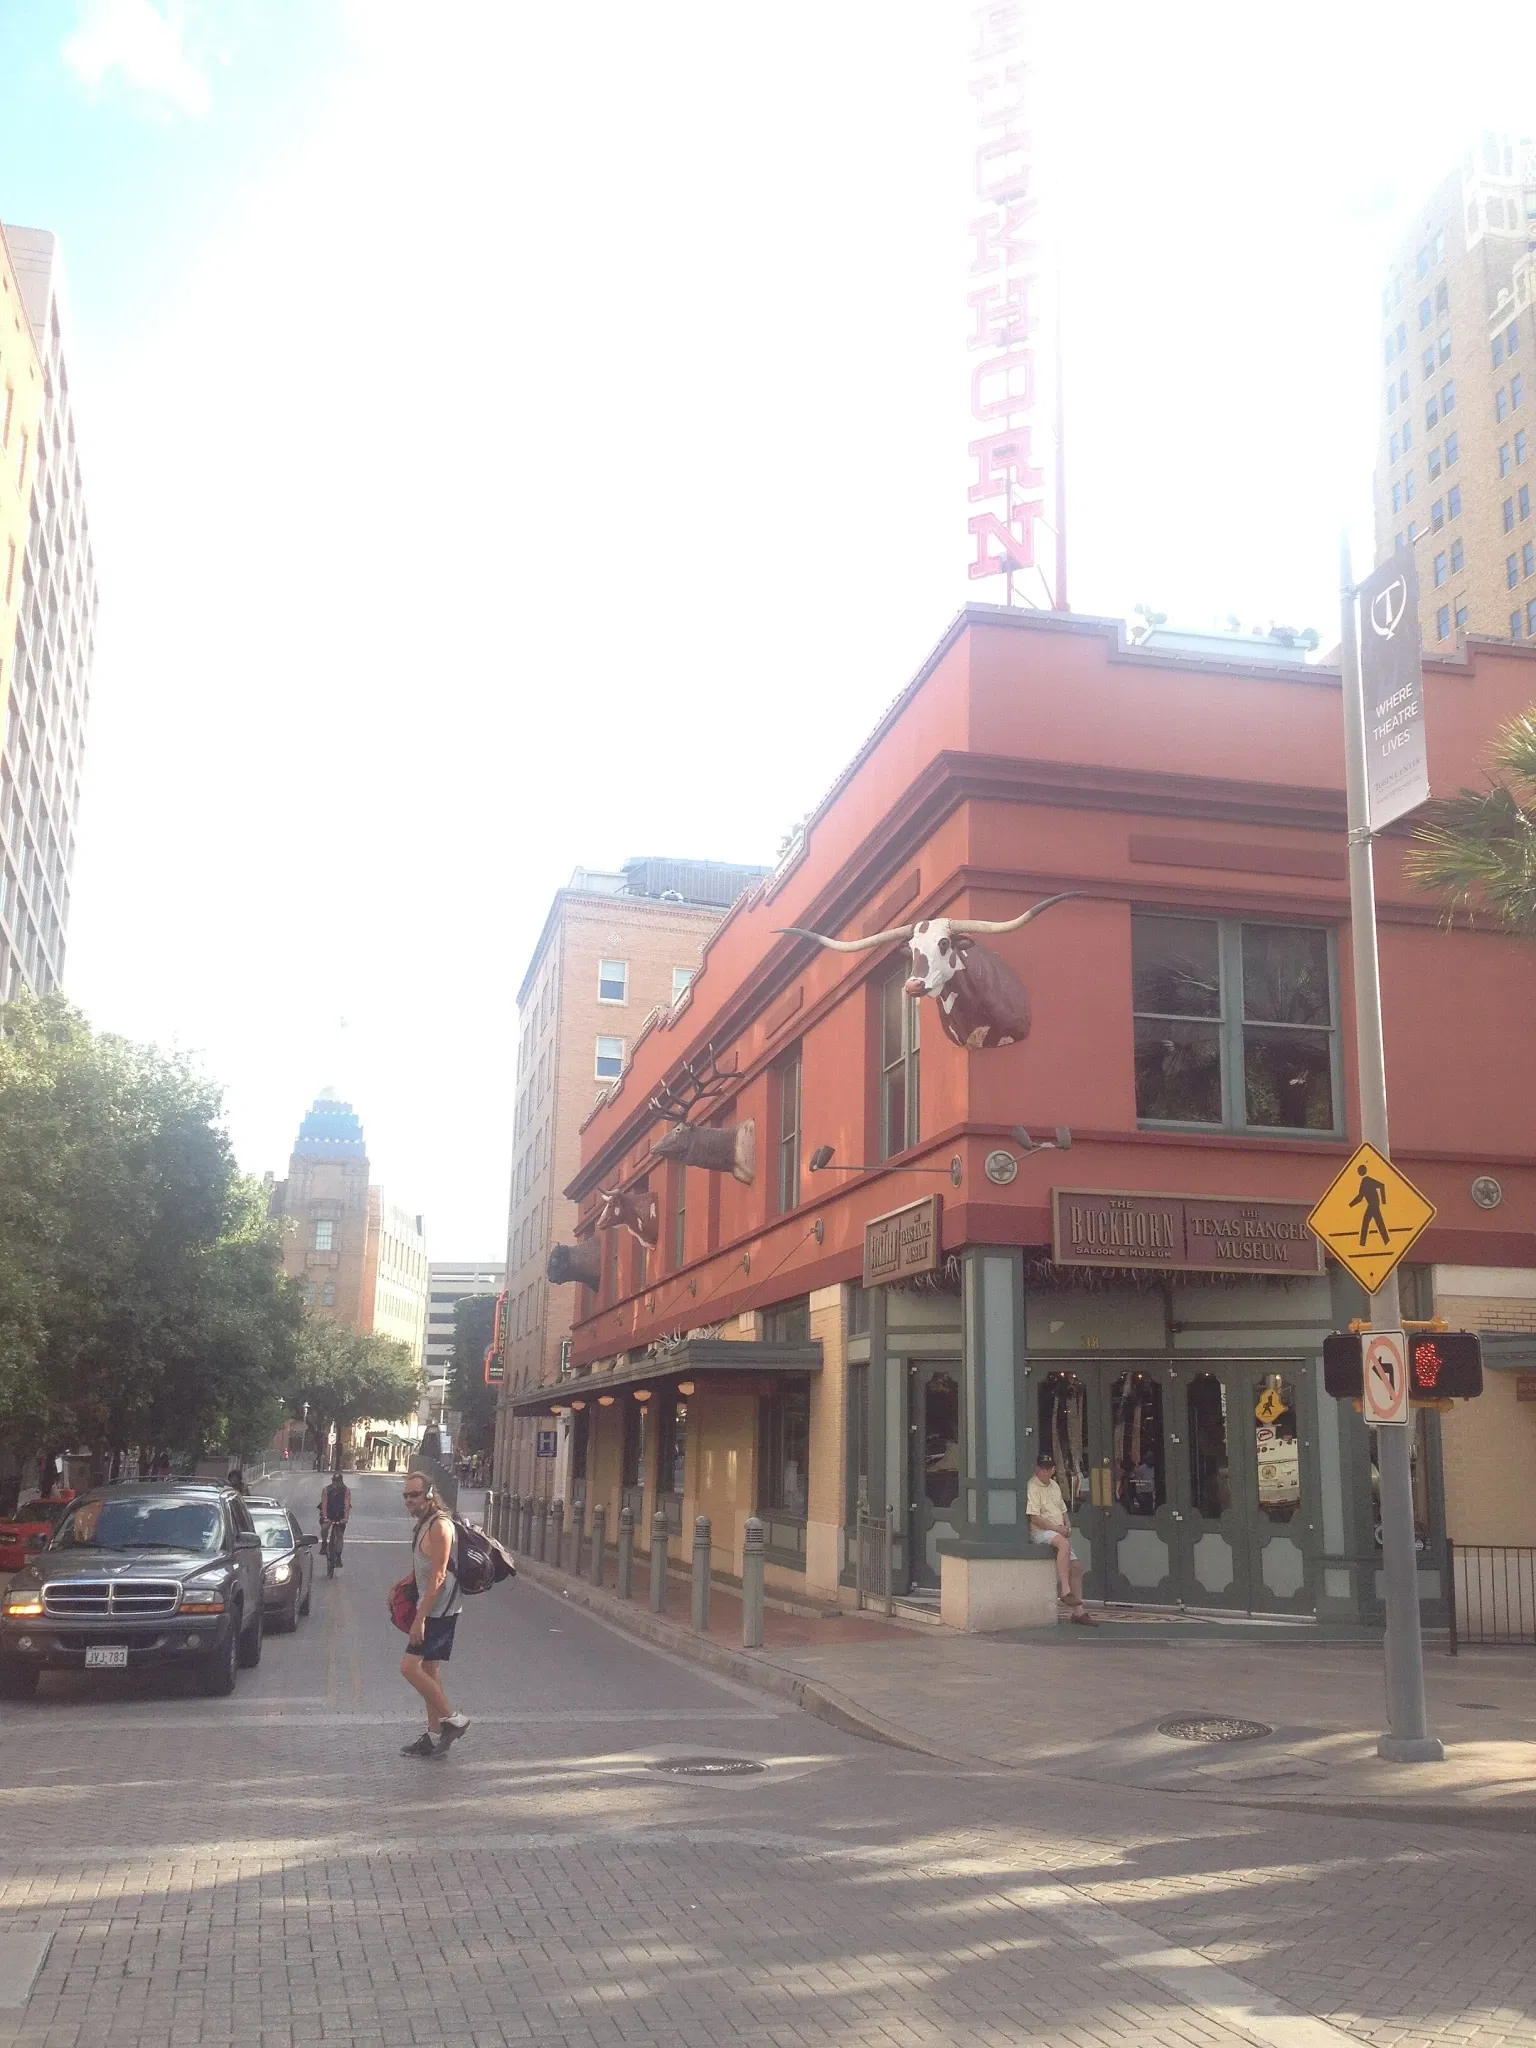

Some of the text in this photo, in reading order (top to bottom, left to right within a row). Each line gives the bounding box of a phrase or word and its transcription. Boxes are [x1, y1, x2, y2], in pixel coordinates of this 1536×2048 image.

[1375, 682, 1413, 718] WHERE
[1372, 700, 1418, 741] THEATRE
[1382, 728, 1410, 757] LIVES
[1109, 1200, 1134, 1209] THE
[1241, 1209, 1260, 1218] THE
[1071, 1206, 1175, 1248] BUCKHORN
[1192, 1217, 1309, 1240] TEXAS RANGER
[1076, 1247, 1116, 1256] SALOON
[1129, 1249, 1172, 1259] MUSEUM
[1216, 1240, 1288, 1261] MUSEUM
